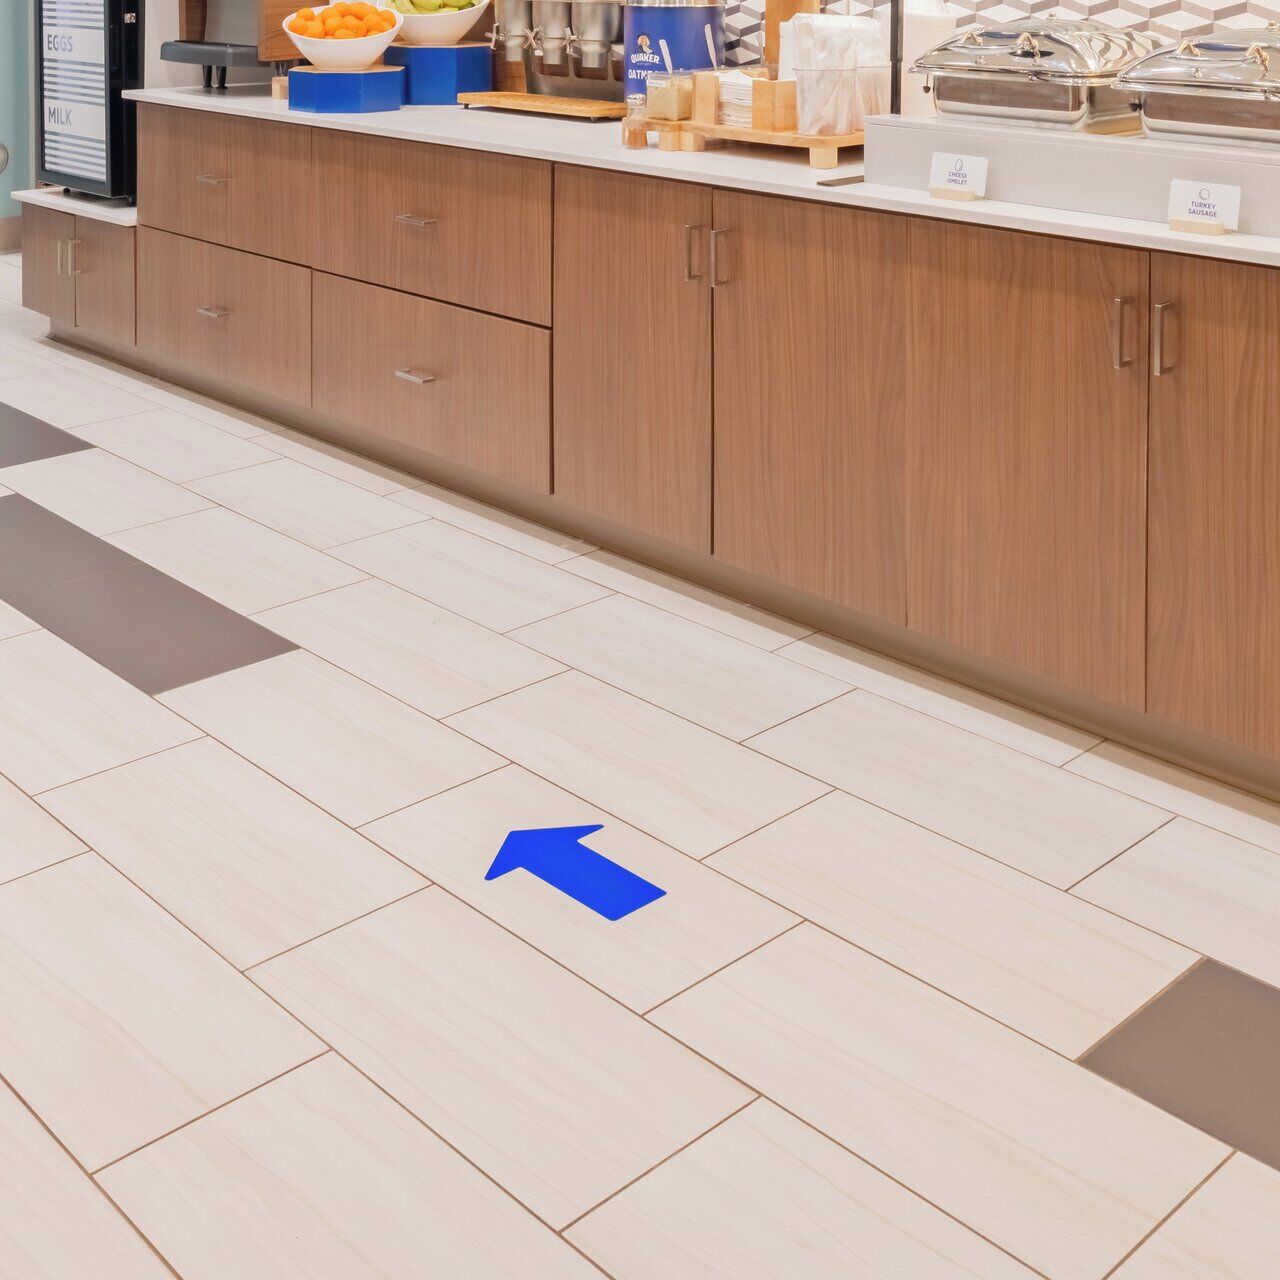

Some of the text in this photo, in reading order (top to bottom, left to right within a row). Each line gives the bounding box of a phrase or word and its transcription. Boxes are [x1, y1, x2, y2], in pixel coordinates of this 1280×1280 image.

[47, 34, 74, 52] EGGS
[631, 53, 660, 64] QUAKER
[48, 106, 72, 126] MILK
[1191, 200, 1216, 209] TURKEY
[1188, 208, 1217, 218] SAUSAGE
